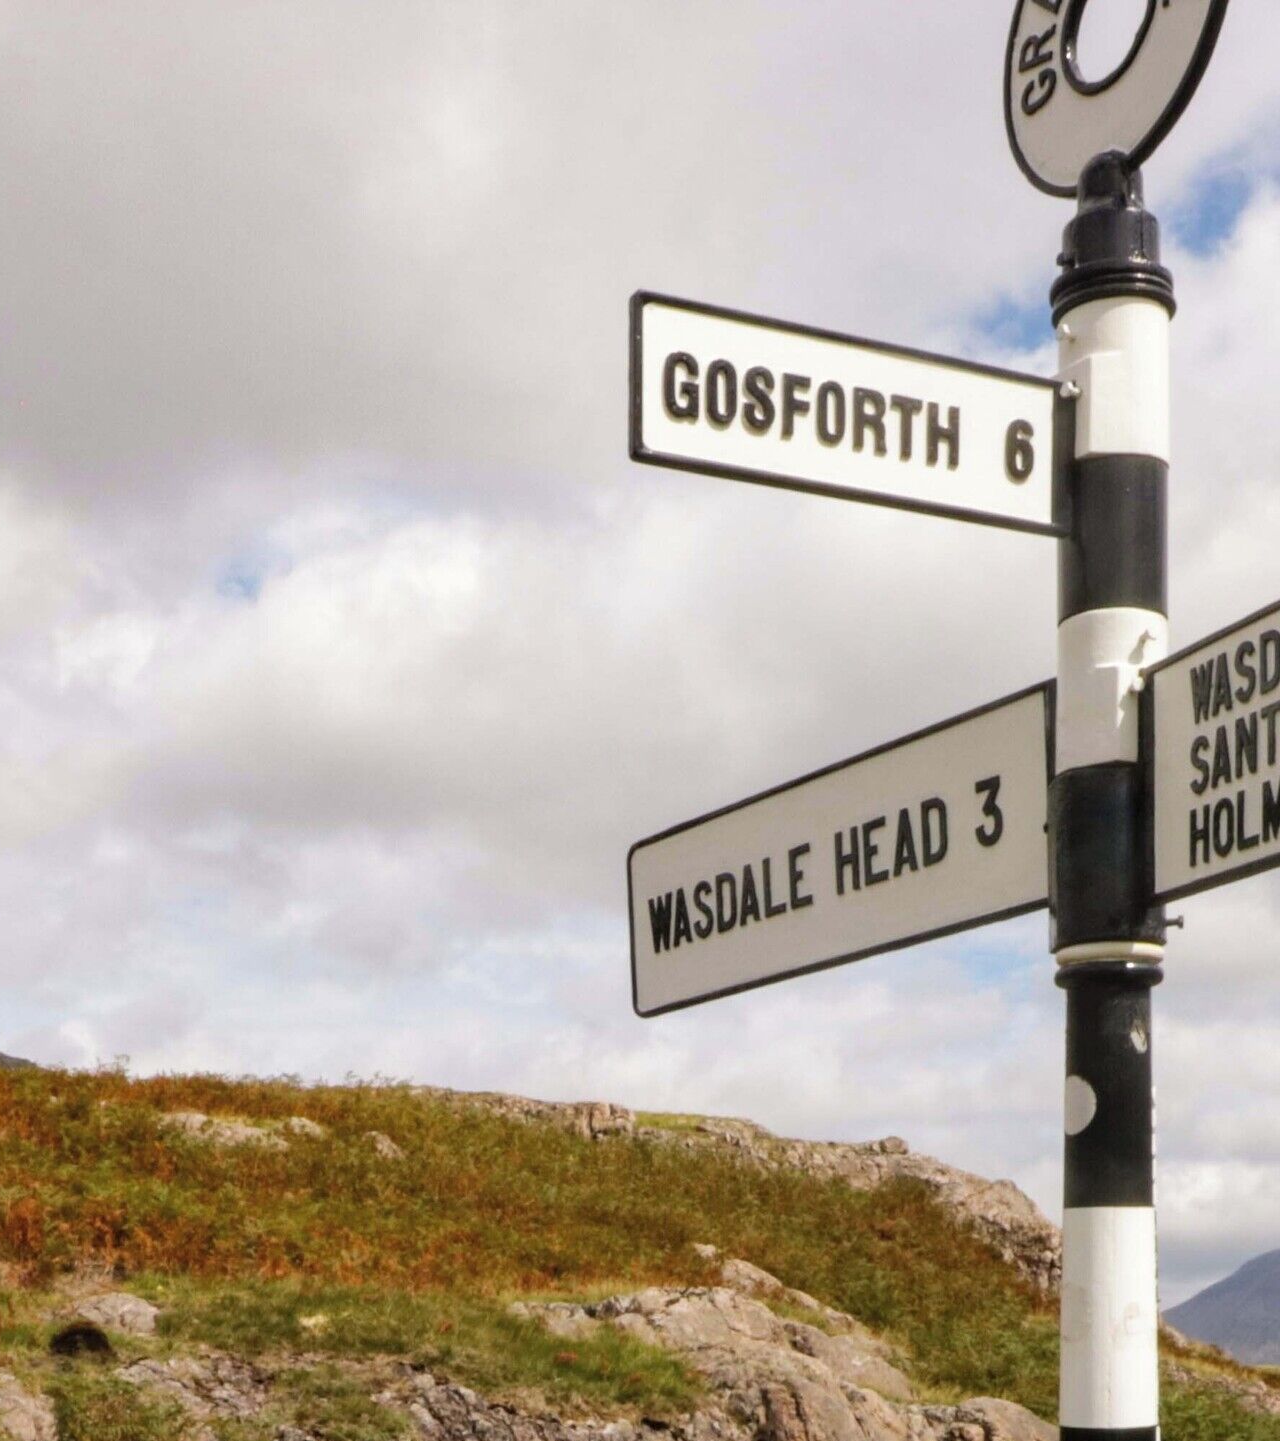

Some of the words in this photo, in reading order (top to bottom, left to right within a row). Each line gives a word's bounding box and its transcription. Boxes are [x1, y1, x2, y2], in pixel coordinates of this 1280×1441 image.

[663, 351, 960, 469] GOSFORTH
[1005, 419, 1035, 484] 6
[647, 842, 814, 955] WASDALE
[834, 796, 949, 896] HEAD
[974, 774, 1005, 848] 3
